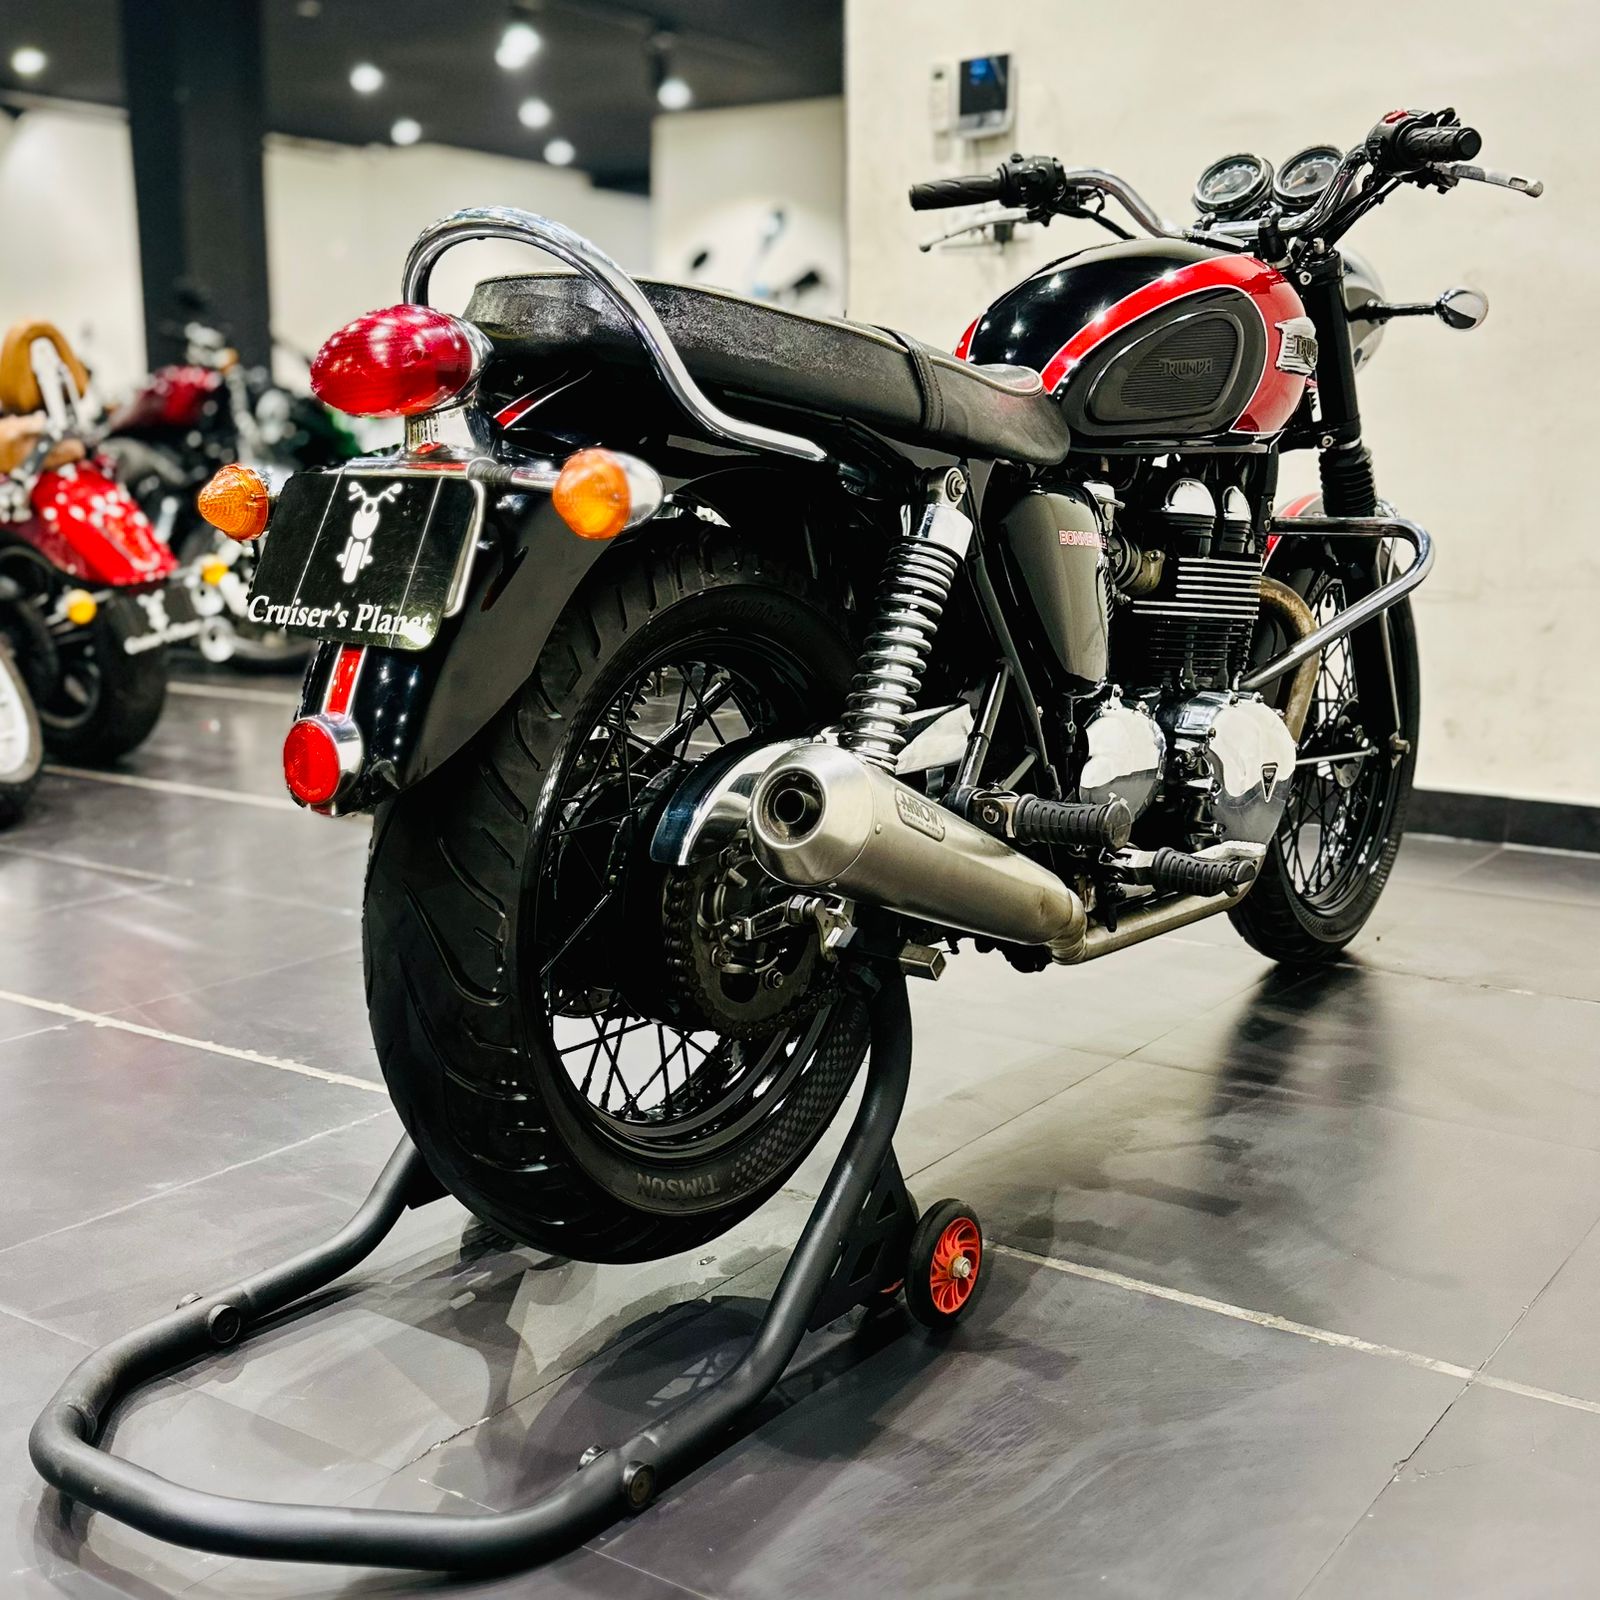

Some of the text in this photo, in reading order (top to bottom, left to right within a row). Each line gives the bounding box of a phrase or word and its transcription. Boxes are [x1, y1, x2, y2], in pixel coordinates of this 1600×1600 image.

[1159, 358, 1213, 382] TRIUMPH
[248, 595, 433, 637] Cruiser's Planet
[635, 1172, 721, 1199] TIMSUN
